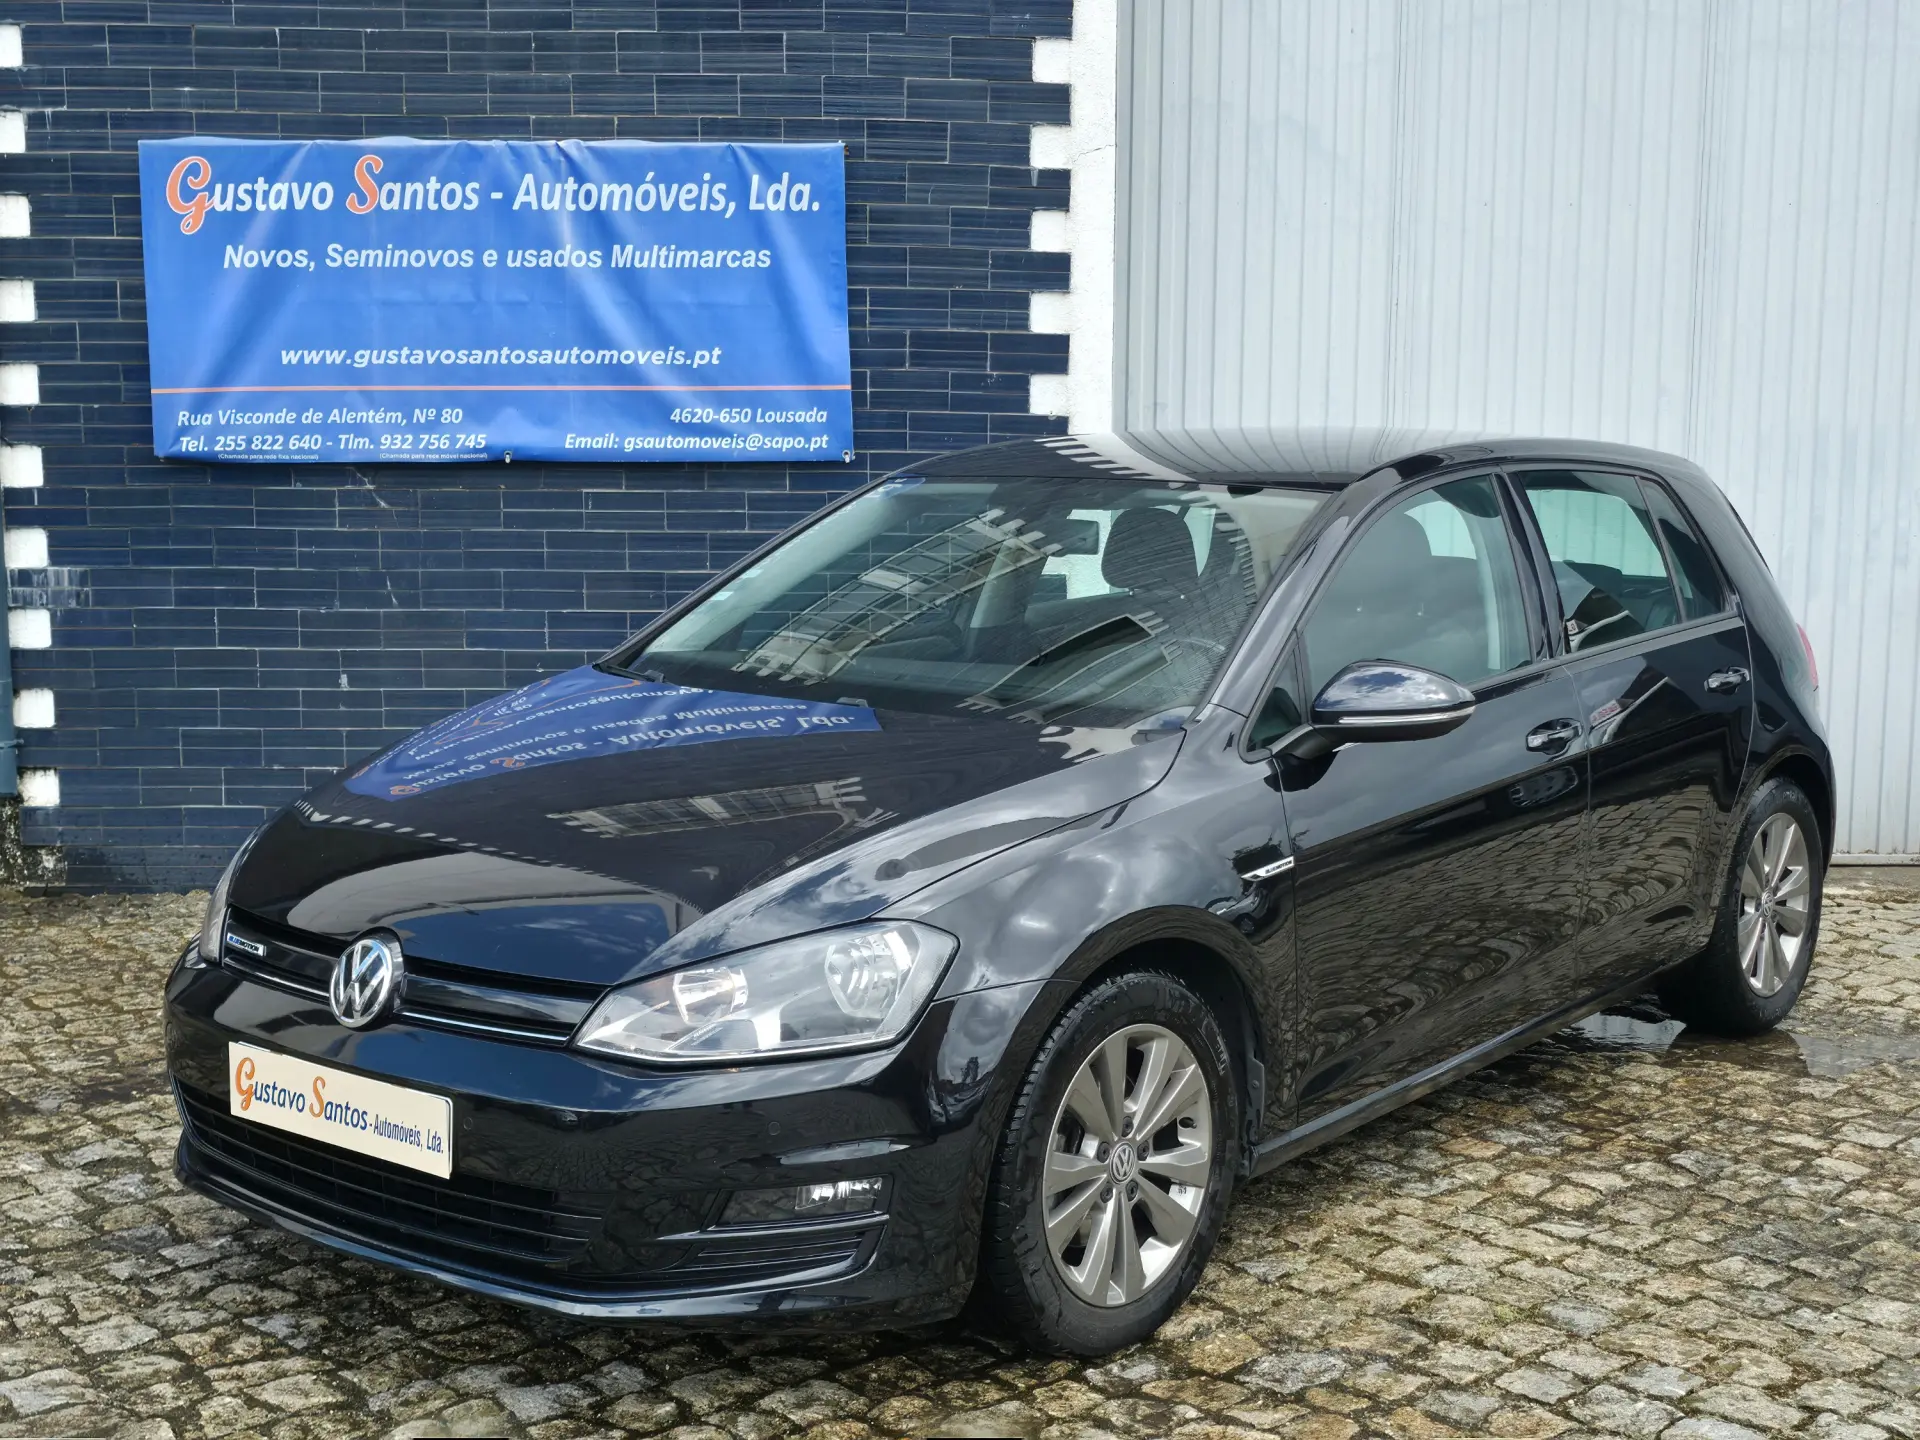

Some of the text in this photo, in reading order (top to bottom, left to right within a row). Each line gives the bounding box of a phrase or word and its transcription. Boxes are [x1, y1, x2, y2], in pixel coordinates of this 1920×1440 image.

[165, 154, 820, 235] Gustavo Santos - Automóveis, Lda.
[223, 243, 771, 271] Novos, Seminovos e usados Multimarcas
[280, 346, 722, 369] www.gustavosantosautomoveis.pt
[177, 411, 212, 427] Rua
[218, 408, 297, 425] Visconde
[301, 408, 322, 424] de
[327, 407, 407, 427] Alentém,
[441, 408, 463, 424] 80
[670, 407, 828, 424] 4620-650 Lousada
[180, 436, 209, 452] Tel.
[214, 435, 247, 451] 255
[251, 435, 284, 450] 822
[288, 434, 322, 450] 640
[338, 433, 374, 450] Tlm.
[380, 434, 413, 449] 932
[418, 434, 450, 449] 756
[455, 434, 487, 449] 745
[564, 434, 828, 452] Email: gsautomoveis@sapo.pt
[235, 1057, 306, 1113] Gustavo
[308, 1076, 369, 1132] Santos
[373, 1113, 424, 1152] Automóveis,
[426, 1127, 444, 1155] Lda.
